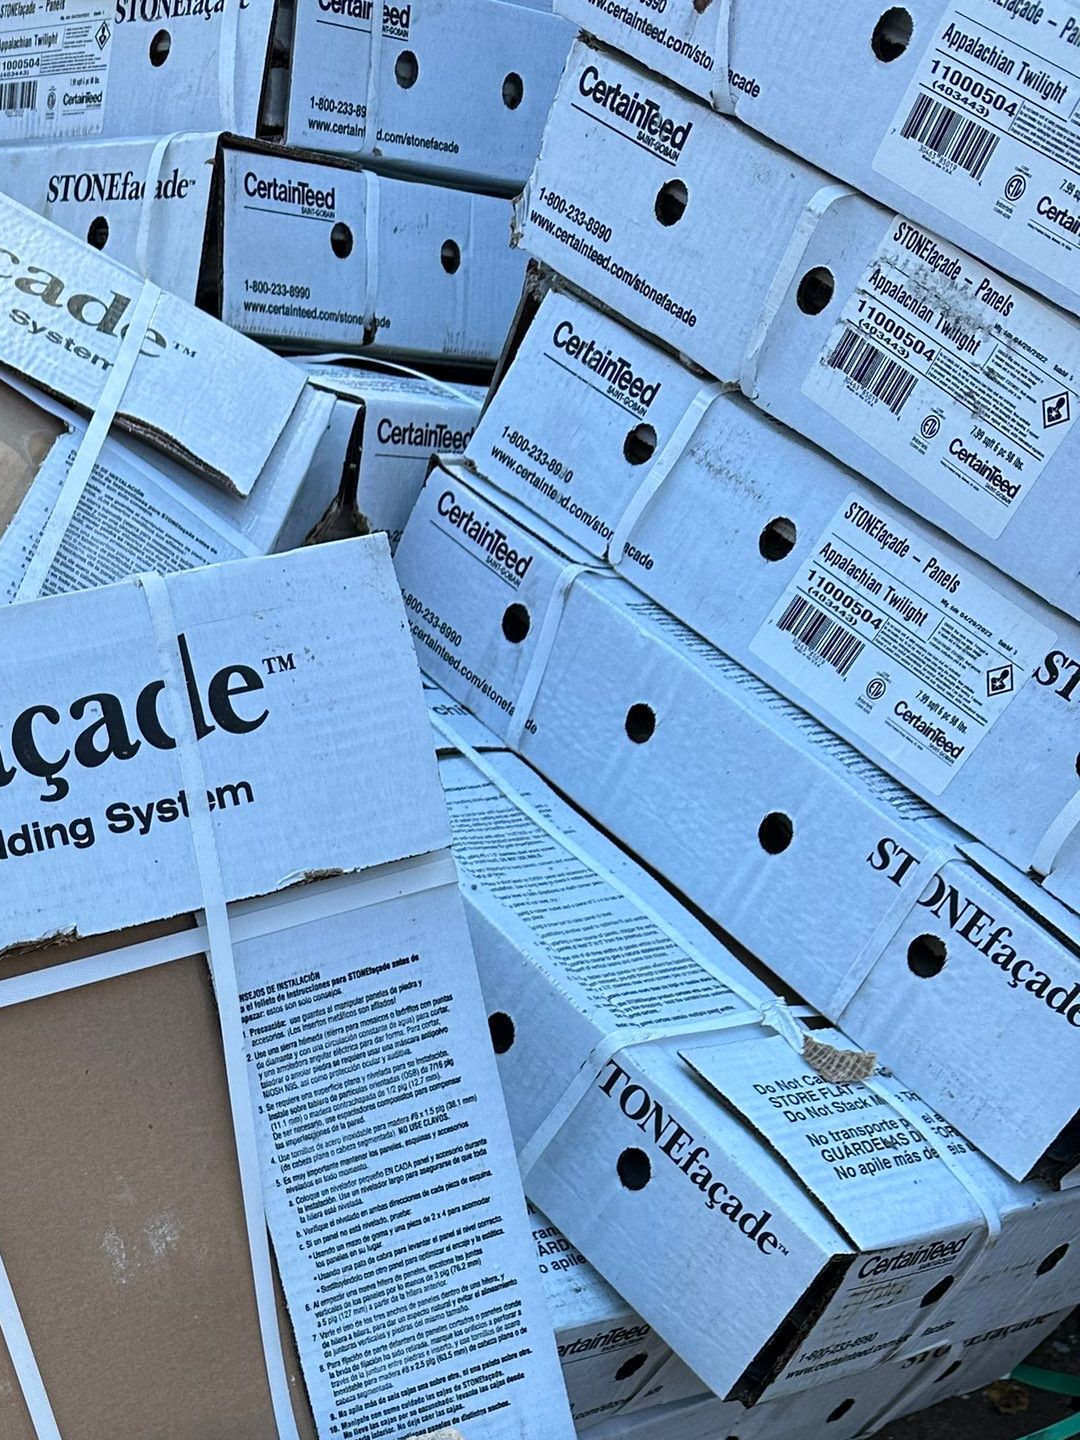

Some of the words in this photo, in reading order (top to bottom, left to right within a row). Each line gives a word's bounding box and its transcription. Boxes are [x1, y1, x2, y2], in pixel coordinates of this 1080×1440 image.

[931, 58, 1019, 119] 11000504
[941, 22, 1015, 76] Appalachian
[1016, 60, 1069, 104] Twilight
[310, 95, 367, 118] 1-800-233-89
[578, 65, 693, 152] CertainTeed
[932, 79, 990, 119] (403443)
[244, 171, 336, 211] CertainTeed
[538, 186, 613, 243] 1-800-233-8990
[244, 279, 311, 300] 1-800-233-8990
[530, 209, 698, 328] www.certainteed.com/stonefacade
[893, 221, 962, 281] STONEfaçade
[974, 277, 1014, 318] Panels
[857, 298, 936, 363] 11000504
[858, 317, 910, 360] (403443)
[553, 320, 662, 408] CertainTeed
[948, 437, 1022, 500] CertainTeed
[437, 490, 534, 579] CertainTeed
[843, 501, 910, 560] STONEfaçade
[922, 557, 962, 595] Panels
[806, 568, 884, 632] 11000504
[807, 586, 858, 627] (403443)
[818, 541, 883, 597] Appalachian
[883, 585, 930, 629] Twilight
[893, 700, 966, 761] CertainTeed
[752, 1084, 776, 1095] Do
[774, 1078, 802, 1091] Not
[768, 1090, 821, 1109] STORE
[818, 1083, 853, 1099] FLAT
[783, 1110, 806, 1122] Do
[804, 1104, 834, 1118] Not
[831, 1097, 872, 1113] Stack
[597, 1058, 789, 1257] TONEfaçade™
[805, 1133, 829, 1147] No
[828, 1119, 899, 1142] transporte
[820, 1132, 911, 1163] GUÁRDELAS
[833, 1166, 856, 1180] No
[858, 1157, 892, 1176] apile
[892, 1151, 921, 1166] más
[922, 1146, 940, 1160] de
[550, 1254, 588, 1272] apile
[857, 1233, 973, 1279] CertainTeed
[557, 1323, 651, 1358] ertainTeed
